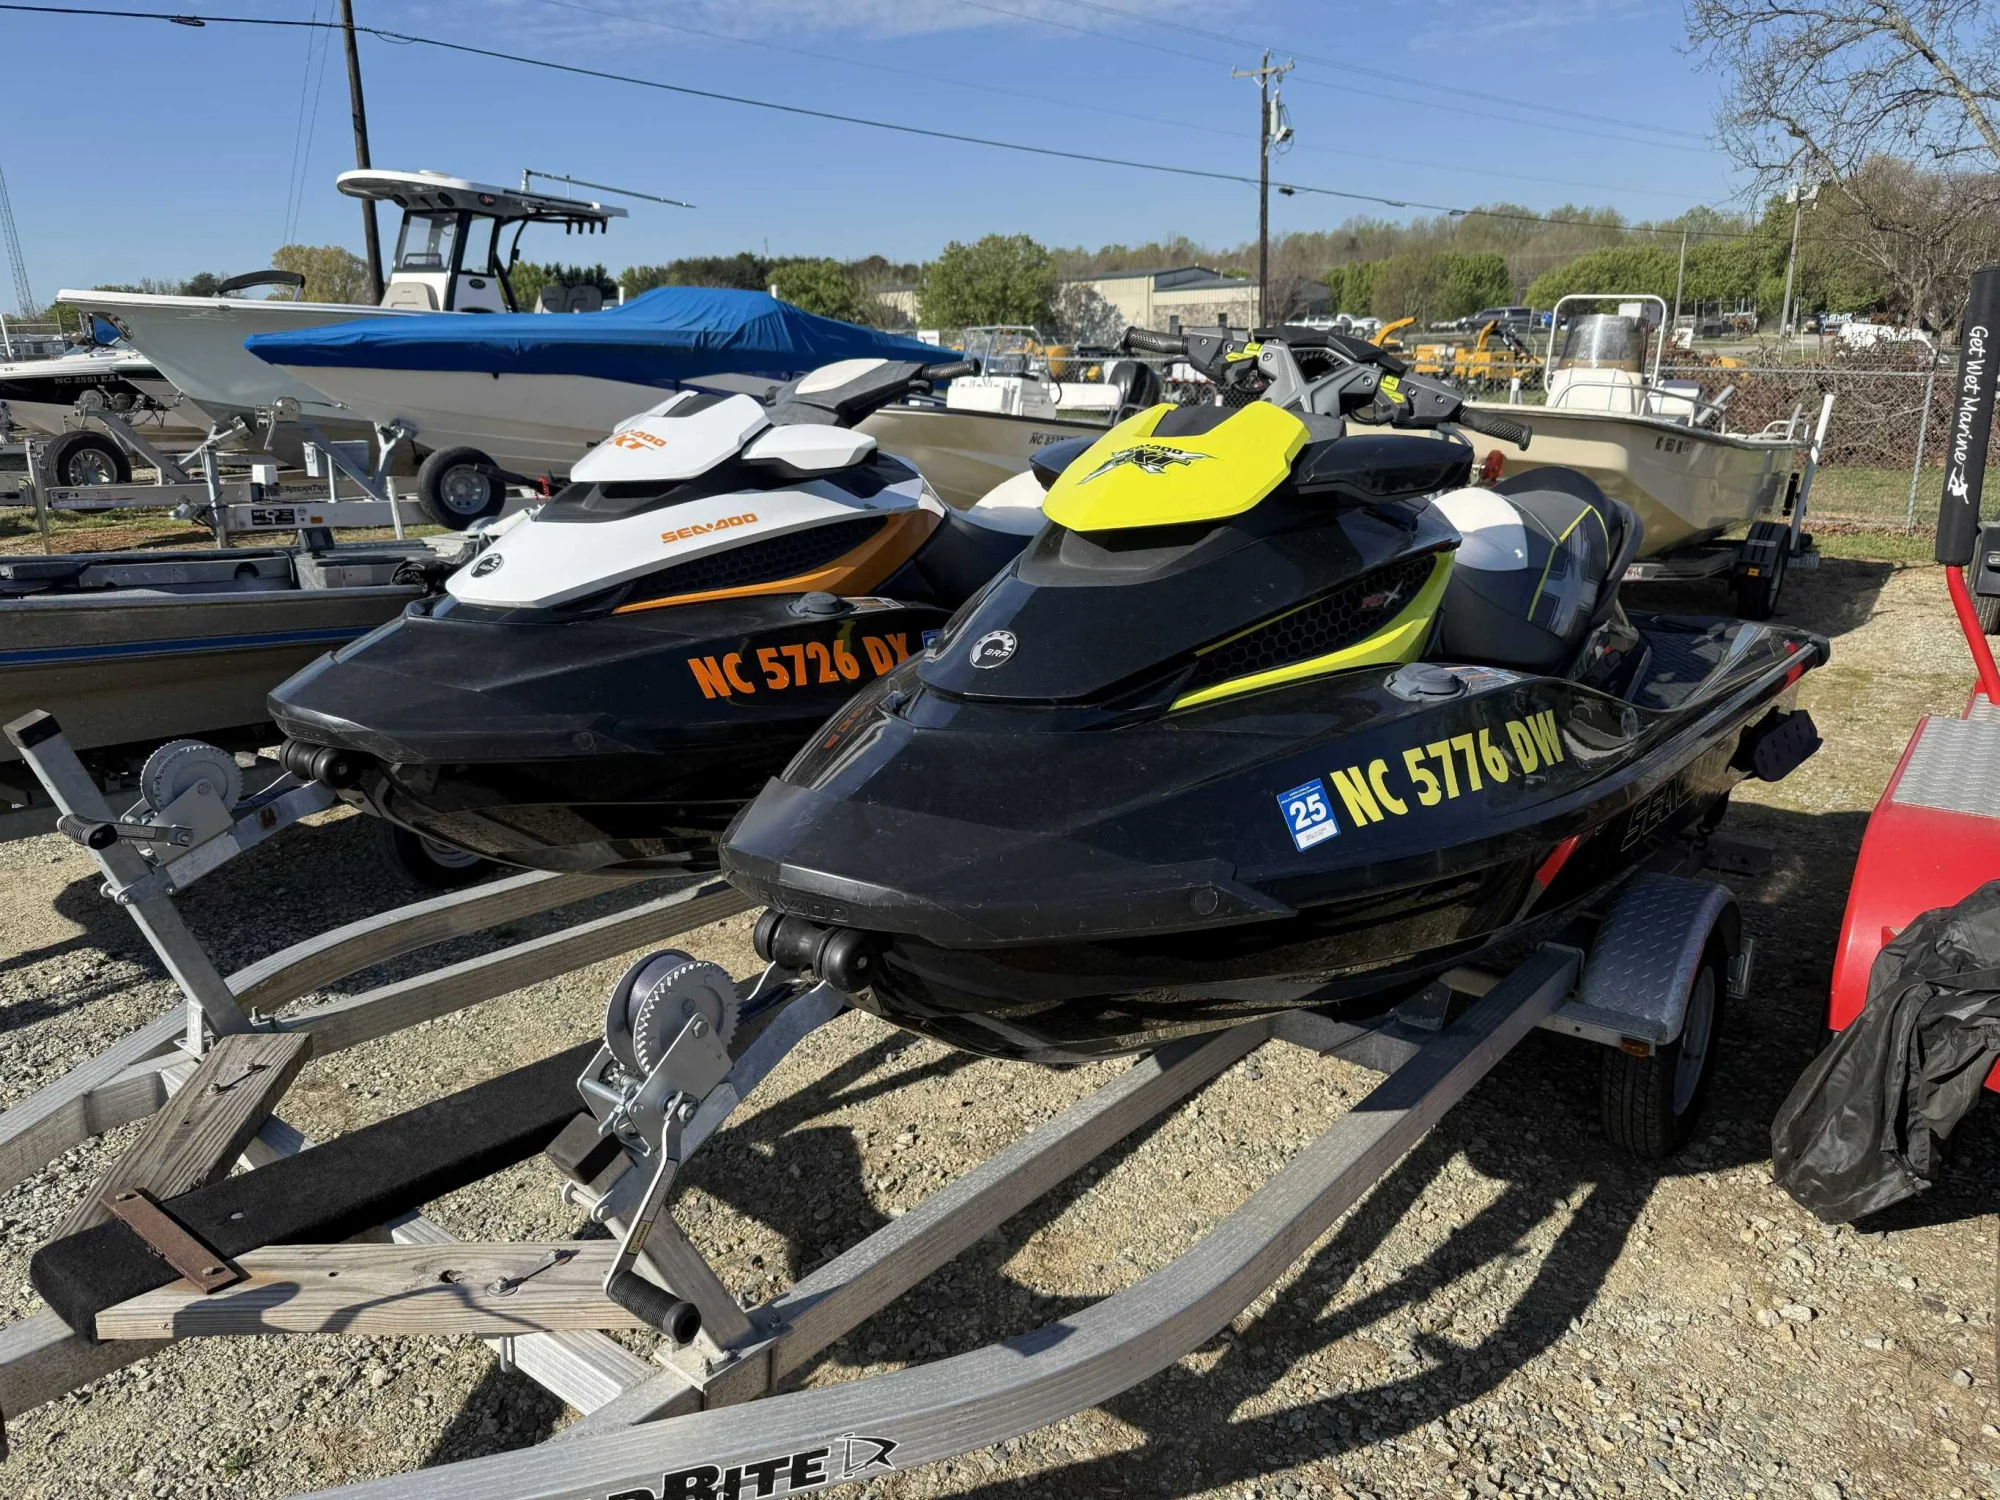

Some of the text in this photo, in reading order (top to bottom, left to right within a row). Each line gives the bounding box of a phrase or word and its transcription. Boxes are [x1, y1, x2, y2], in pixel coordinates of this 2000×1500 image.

[54, 377, 72, 385] NC
[1954, 325, 1989, 466] Get Wet Marine
[687, 652, 756, 699] NC
[756, 639, 861, 690] 5726
[983, 648, 1010, 658] BRP
[1329, 709, 1564, 828] NC 5776 DW
[1289, 792, 1328, 831] 25
